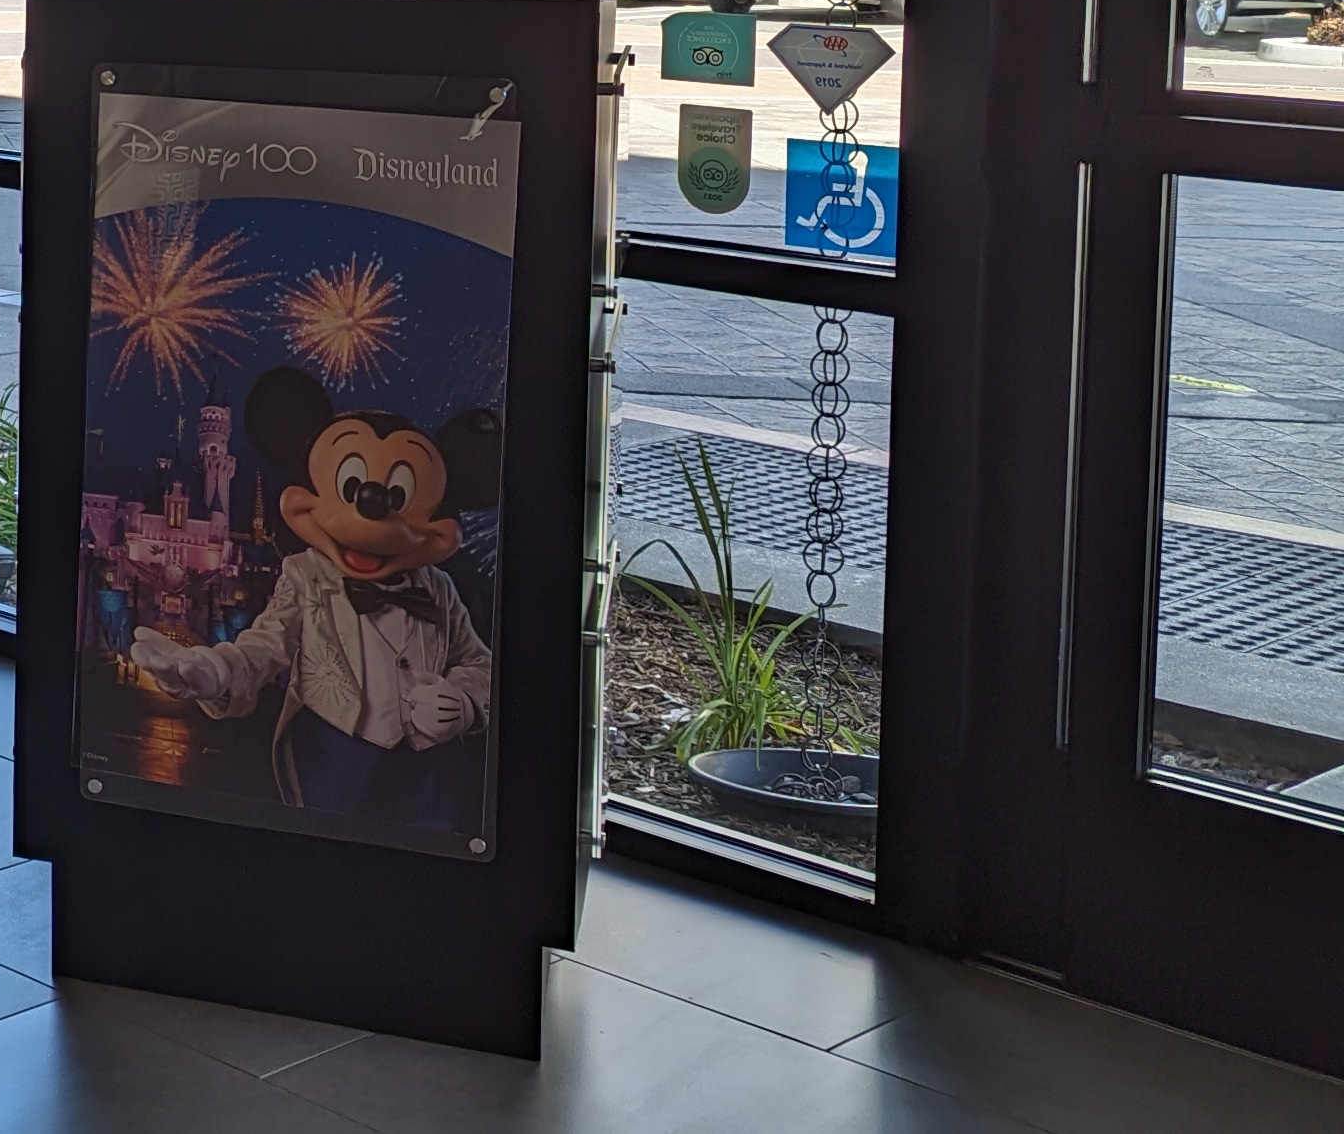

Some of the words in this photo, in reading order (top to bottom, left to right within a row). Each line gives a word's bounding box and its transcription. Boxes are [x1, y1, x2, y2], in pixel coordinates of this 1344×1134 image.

[113, 121, 241, 183] Disney
[245, 142, 317, 176] 100
[352, 145, 498, 190] Disneyland
